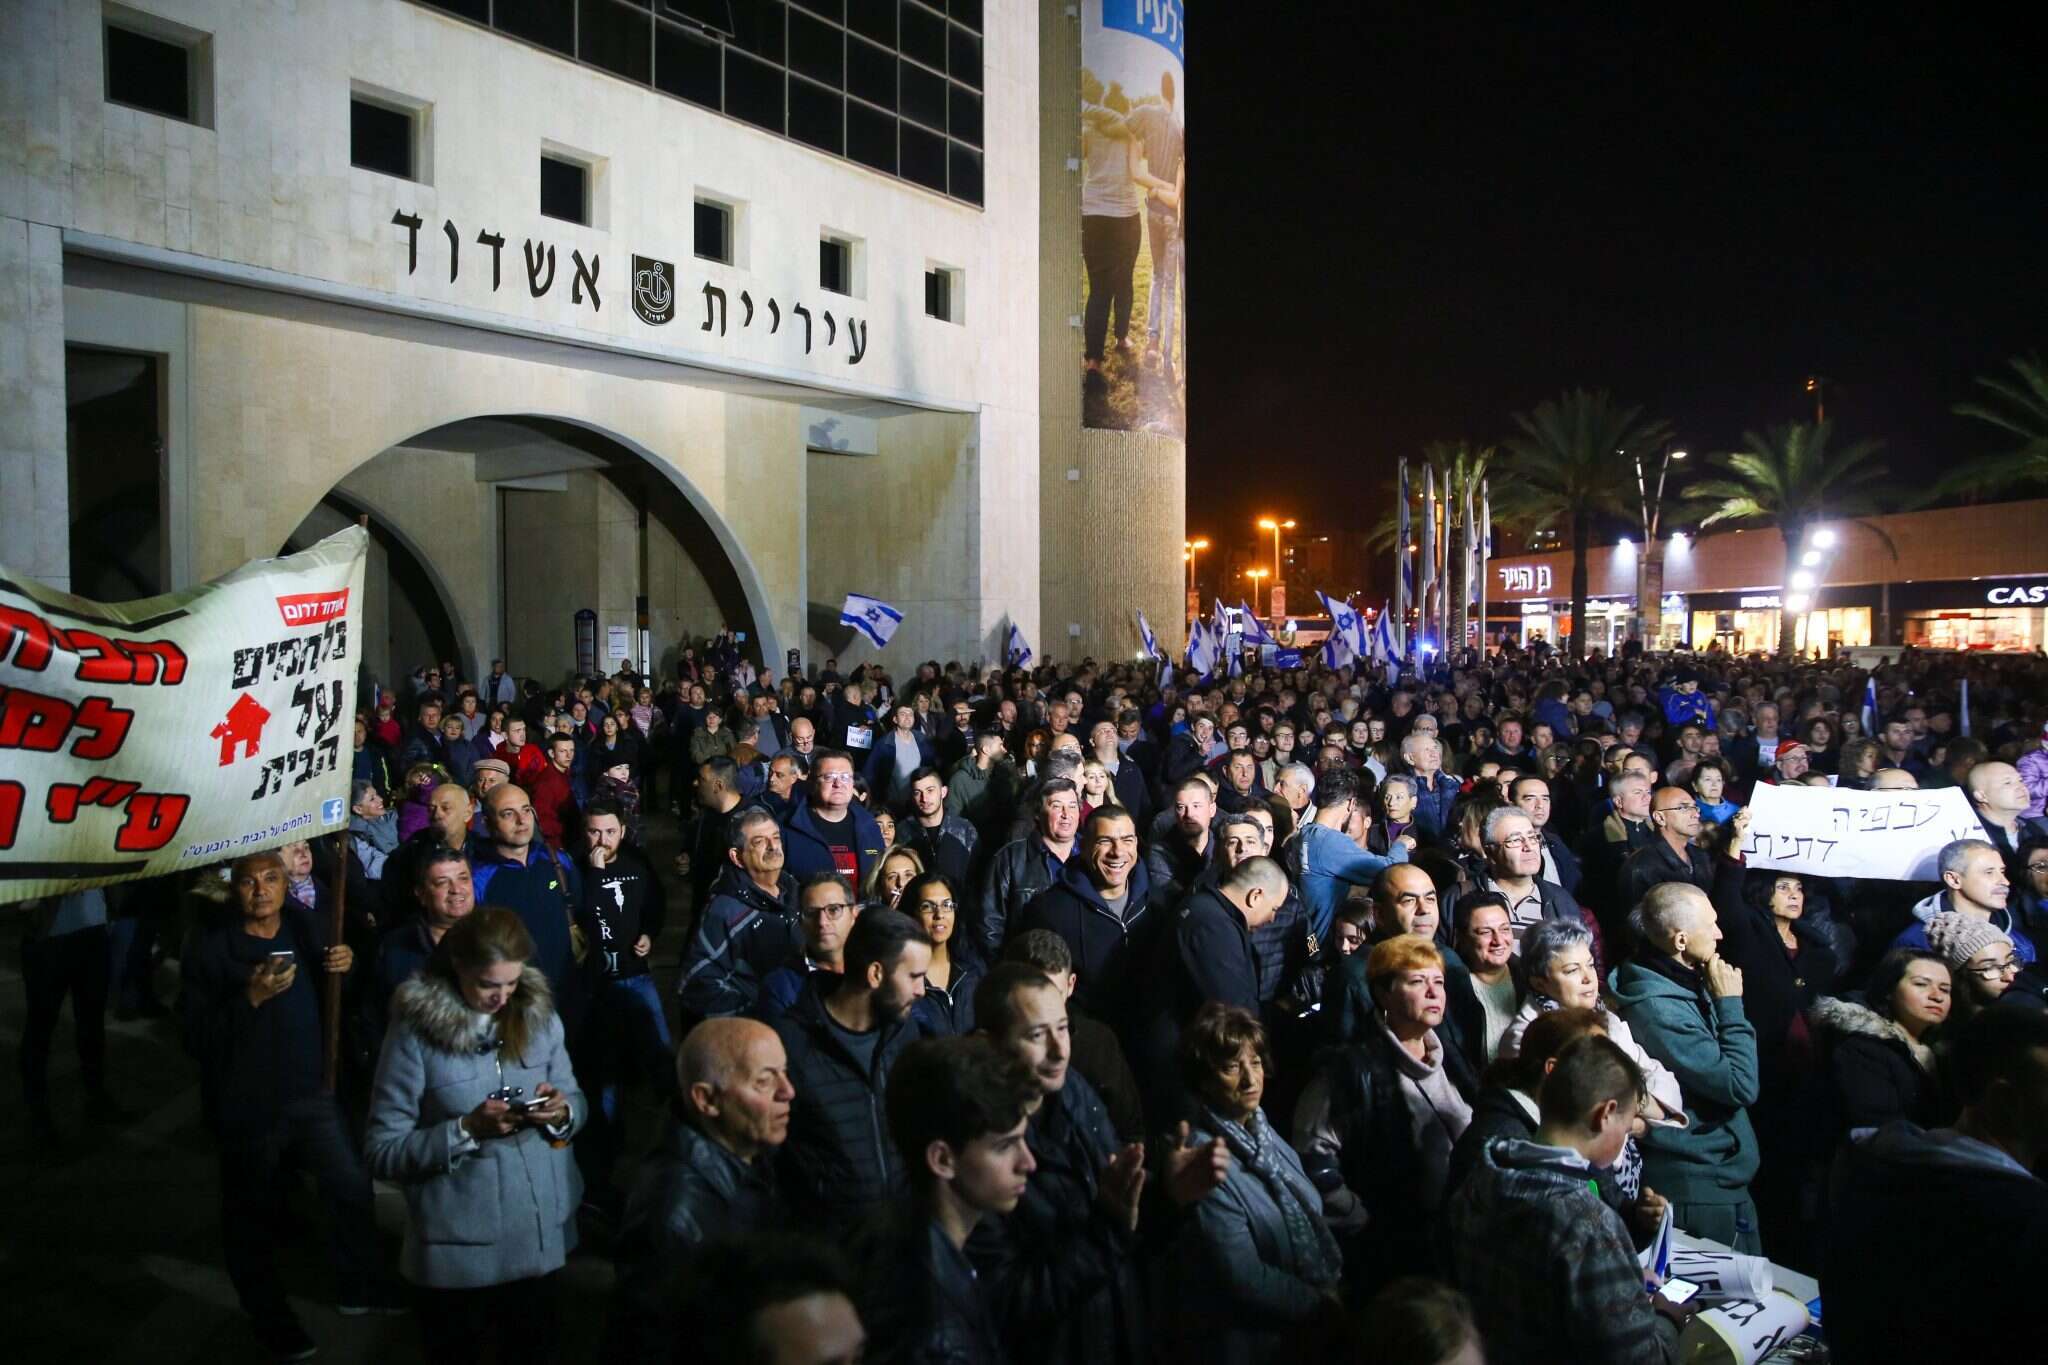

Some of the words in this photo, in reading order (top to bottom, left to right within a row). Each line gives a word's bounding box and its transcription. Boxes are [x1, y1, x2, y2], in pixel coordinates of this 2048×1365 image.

[391, 208, 601, 312] אשדוד
[700, 280, 867, 365] עיריית
[283, 602, 319, 619] דרום
[232, 619, 347, 689] נלחמים
[290, 679, 343, 743] על
[251, 735, 339, 801] הבית
[241, 830, 267, 846] הבית
[269, 825, 280, 836] על
[282, 812, 312, 833] נלחמים
[205, 839, 230, 855] רובע
[1740, 831, 1839, 863] דתית
